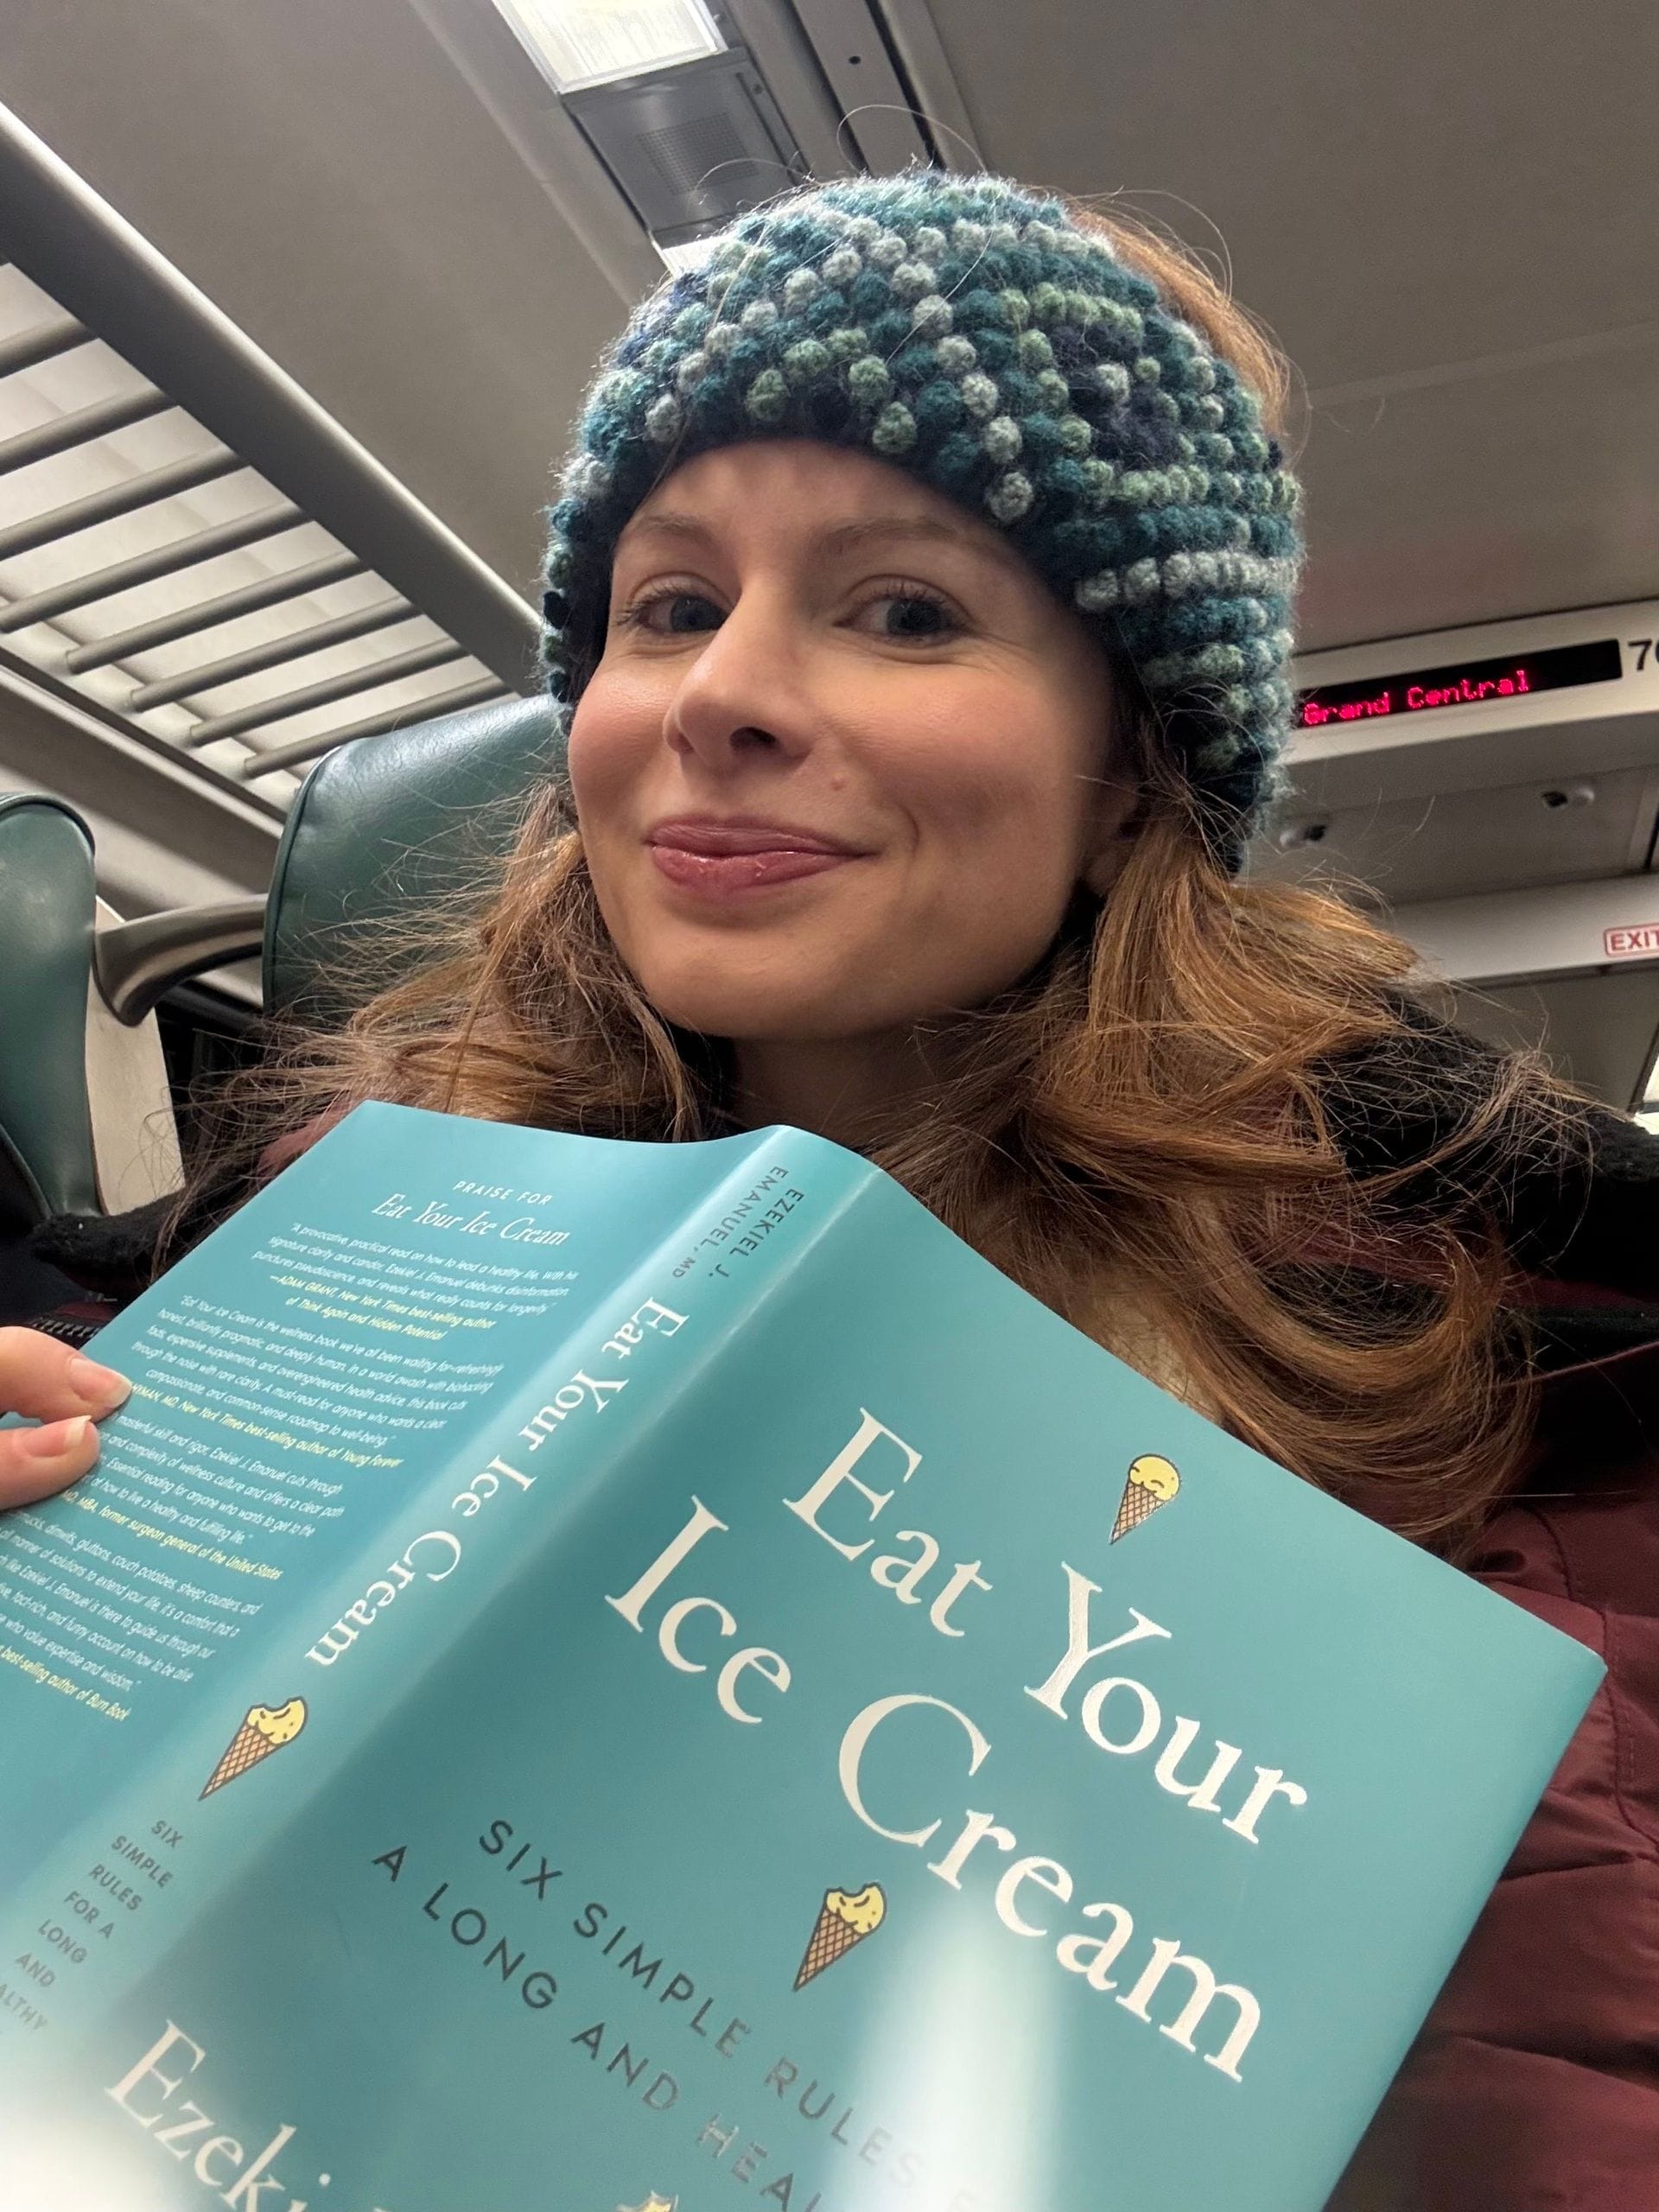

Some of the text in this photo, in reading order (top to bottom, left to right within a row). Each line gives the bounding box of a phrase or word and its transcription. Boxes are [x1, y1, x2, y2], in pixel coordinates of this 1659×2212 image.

[1628, 639, 1659, 671] 7
[1304, 670, 1529, 725] Grand Central
[453, 1180, 553, 1206] PRAISE FOR
[372, 1193, 571, 1245] Eat Your Ice Cream
[672, 1166, 789, 1279] EMANUEL, MD
[709, 1188, 804, 1279] EZEKIEL J.
[347, 1313, 371, 1324] and
[408, 1306, 463, 1327] best-selling
[462, 1319, 496, 1328] author
[168, 1434, 191, 1446] and
[305, 1296, 690, 1666] Eat Your Ice Cream
[208, 1551, 226, 1564] the
[783, 1408, 1307, 1844] Eat Your
[1, 1646, 50, 1683] best-selling
[47, 1675, 78, 1694] author
[605, 1495, 1261, 2082] Ice Cream
[150, 1820, 184, 1848] SIX
[111, 1835, 174, 1888] SIMPLE
[89, 1864, 143, 1911] RULES
[63, 1891, 116, 1939] FOR A
[37, 1919, 87, 1964] LONG
[15, 1952, 56, 1987] AND
[372, 1845, 408, 1882] A
[423, 1882, 557, 2009] LONG
[571, 2022, 679, 2111] AND
[479, 1820, 924, 2188] SIX SIMPLE RULES
[104, 2018, 387, 2212] Ezek
